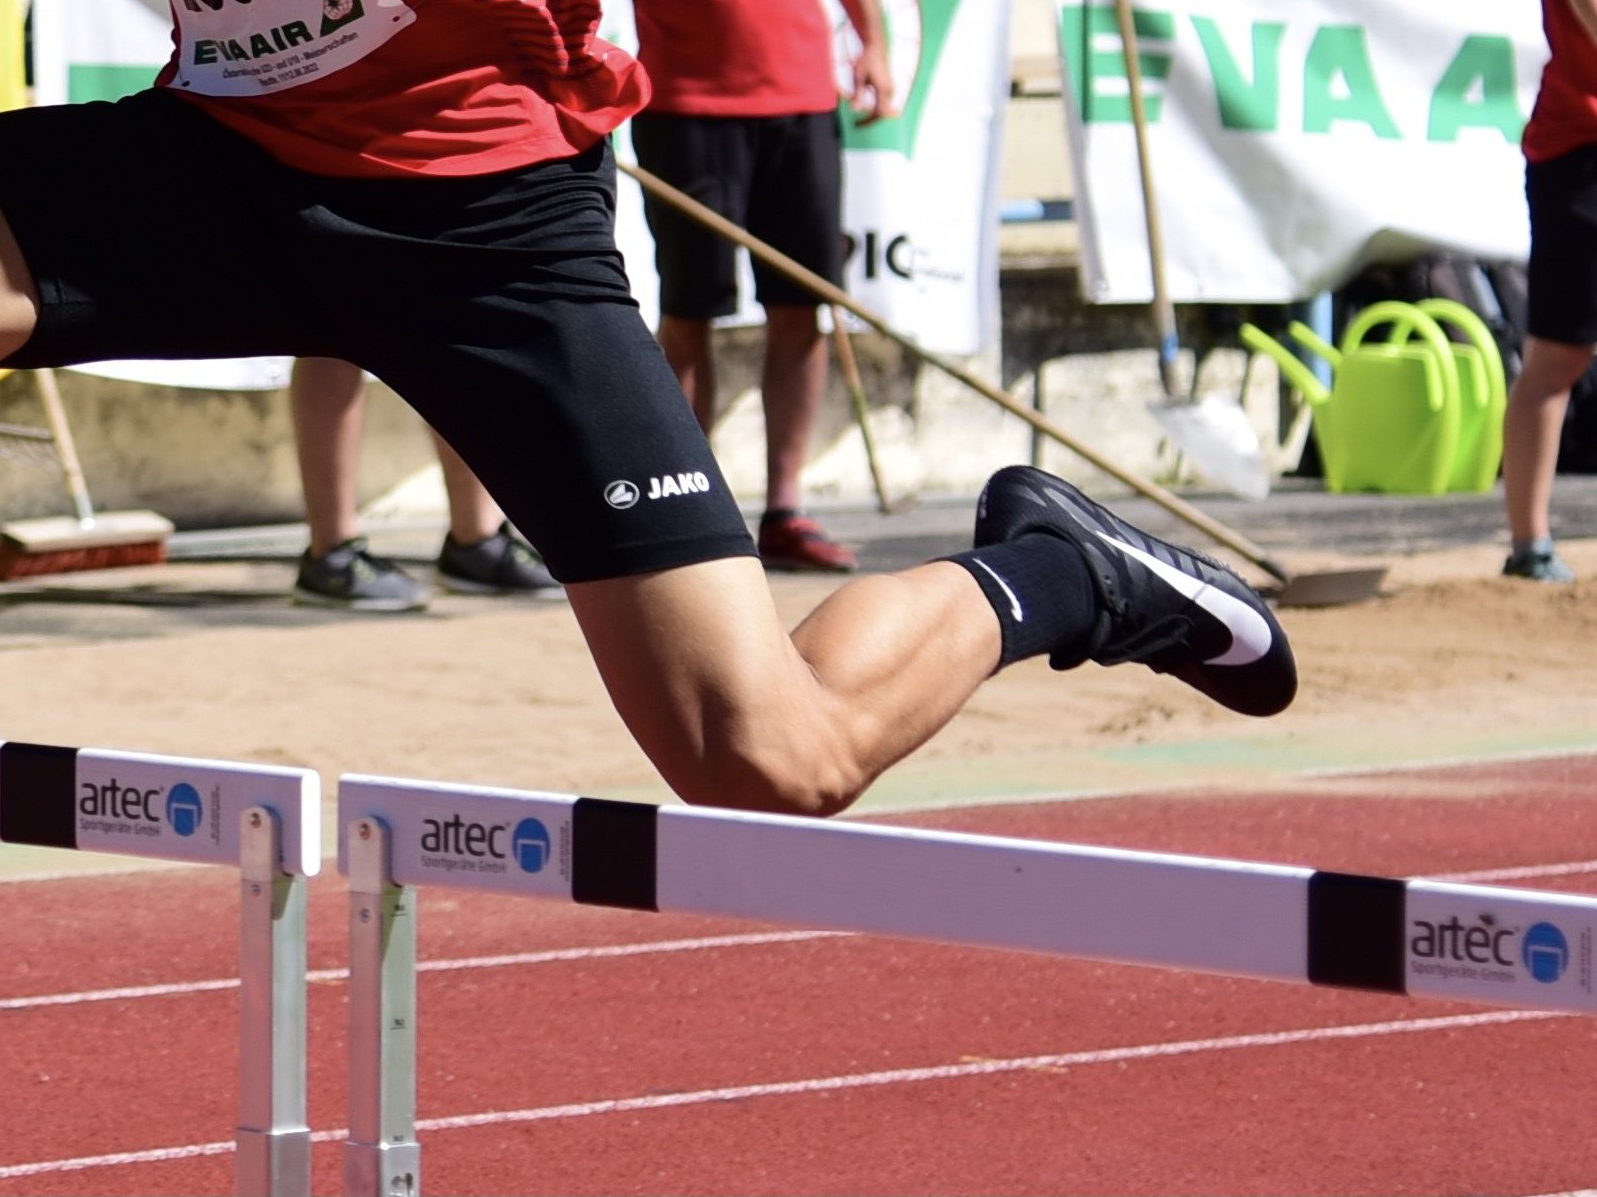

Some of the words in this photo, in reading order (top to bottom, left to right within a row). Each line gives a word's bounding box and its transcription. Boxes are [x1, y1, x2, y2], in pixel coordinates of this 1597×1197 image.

[647, 471, 710, 500] JAKO
[80, 778, 161, 822] artec
[421, 814, 506, 859] artec
[1411, 916, 1515, 966] artec
